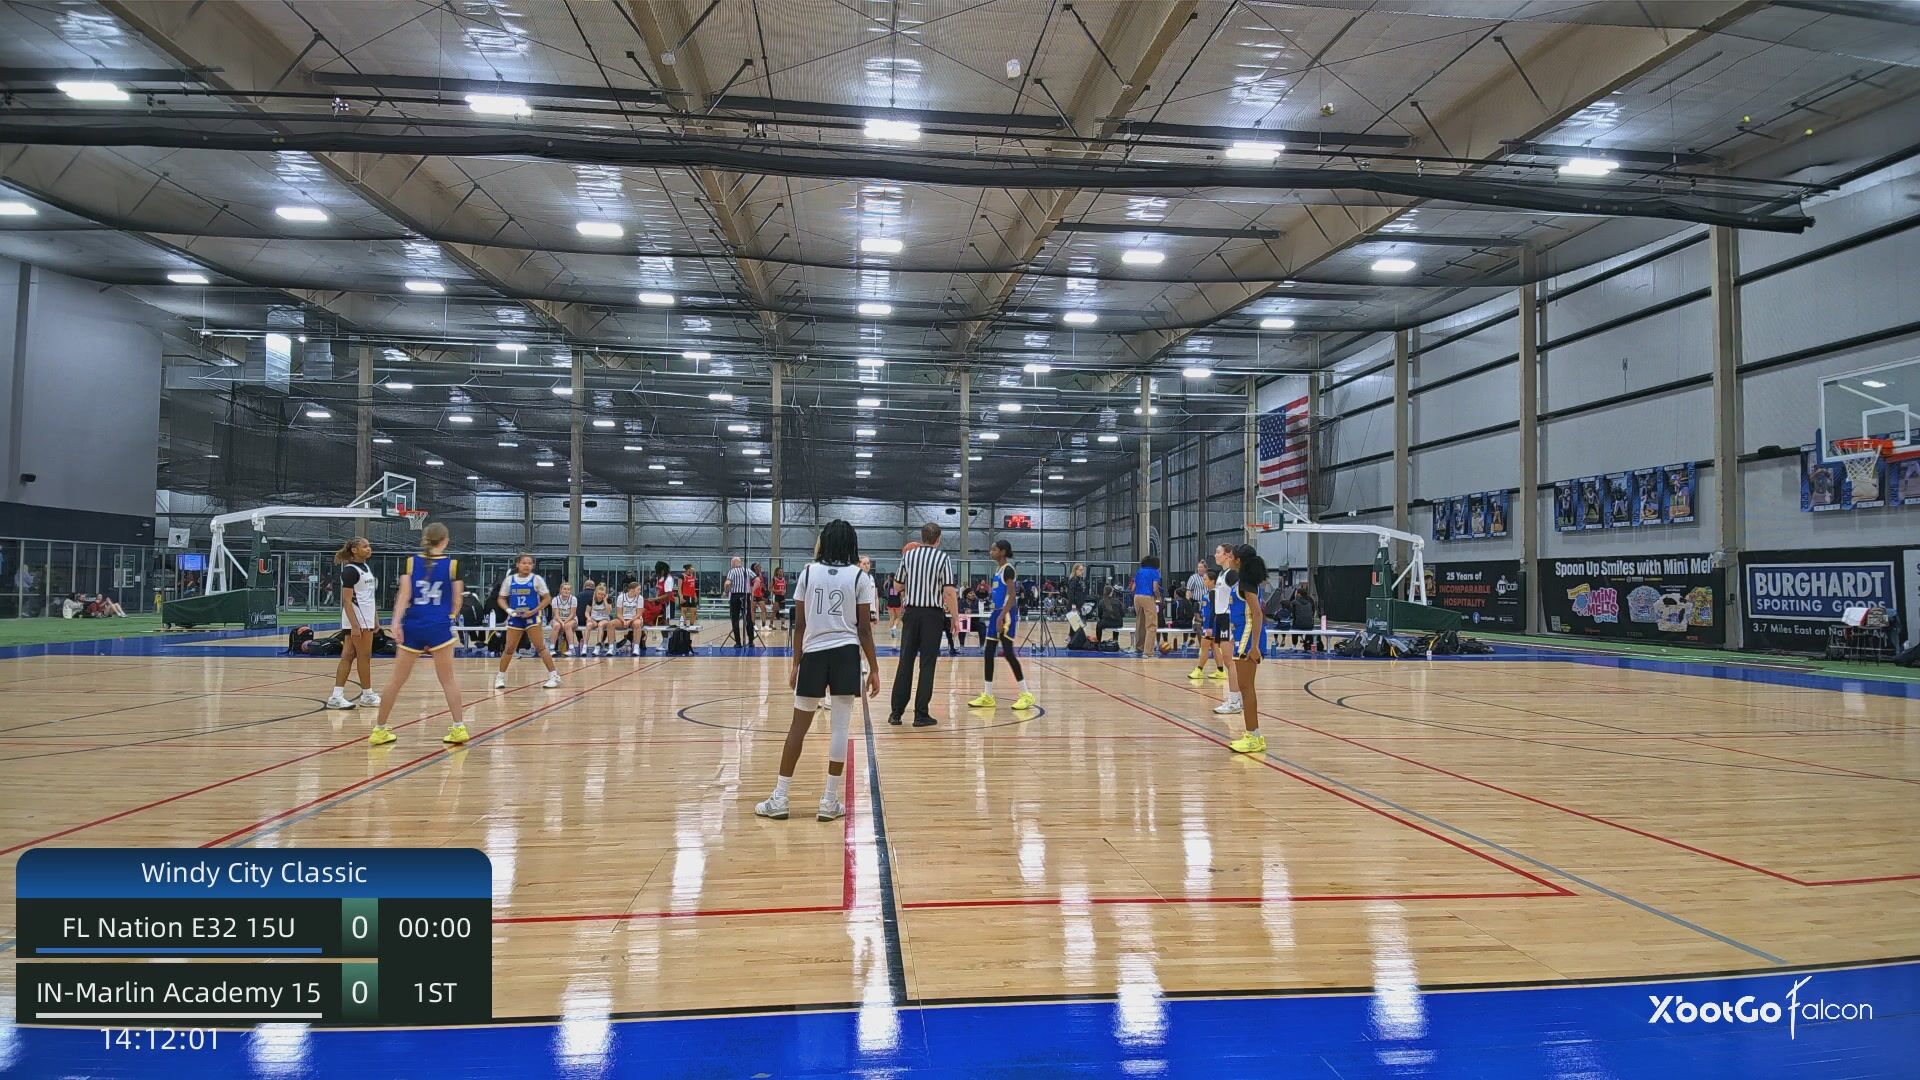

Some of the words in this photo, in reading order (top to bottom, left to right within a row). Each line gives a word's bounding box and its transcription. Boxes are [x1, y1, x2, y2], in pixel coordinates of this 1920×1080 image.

[1555, 561, 1584, 577] Spoon
[1586, 561, 1599, 576] Up
[1600, 560, 1635, 576] Smiles
[1636, 558, 1662, 575] with
[1663, 557, 1688, 574] Mini
[1446, 572, 1455, 580] 25
[1456, 572, 1474, 580] Years
[1475, 571, 1482, 580] of
[1440, 585, 1491, 594] INCOMPARABLE
[1755, 571, 1885, 597] BURGHARDT
[414, 580, 443, 606] 34
[516, 595, 527, 606] 12
[815, 588, 844, 616] 12
[1444, 597, 1486, 607] HOSPITALITY
[1757, 598, 1823, 612] SPORTING
[1587, 602, 1618, 616] MELTS
[1753, 622, 1767, 632] 3.7
[1770, 623, 1792, 634] Miles
[1795, 625, 1812, 636] East
[1815, 628, 1826, 636] on
